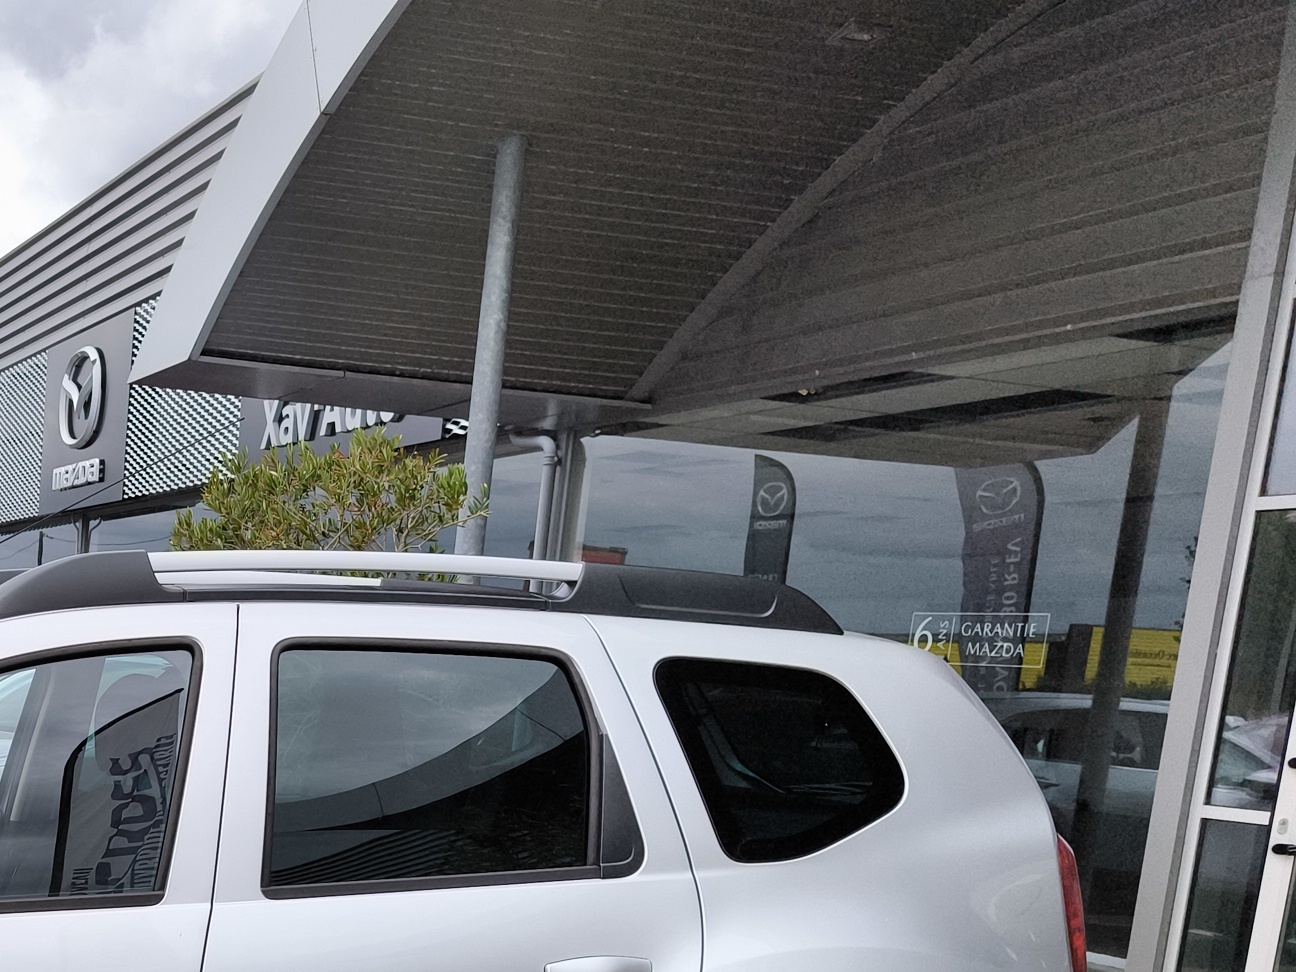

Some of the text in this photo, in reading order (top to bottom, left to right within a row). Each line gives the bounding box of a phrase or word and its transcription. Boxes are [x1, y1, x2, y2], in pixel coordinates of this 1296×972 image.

[913, 616, 950, 651] 6 ANS
[961, 621, 1038, 638] GARANTIE
[965, 641, 1024, 658] MAZDA
